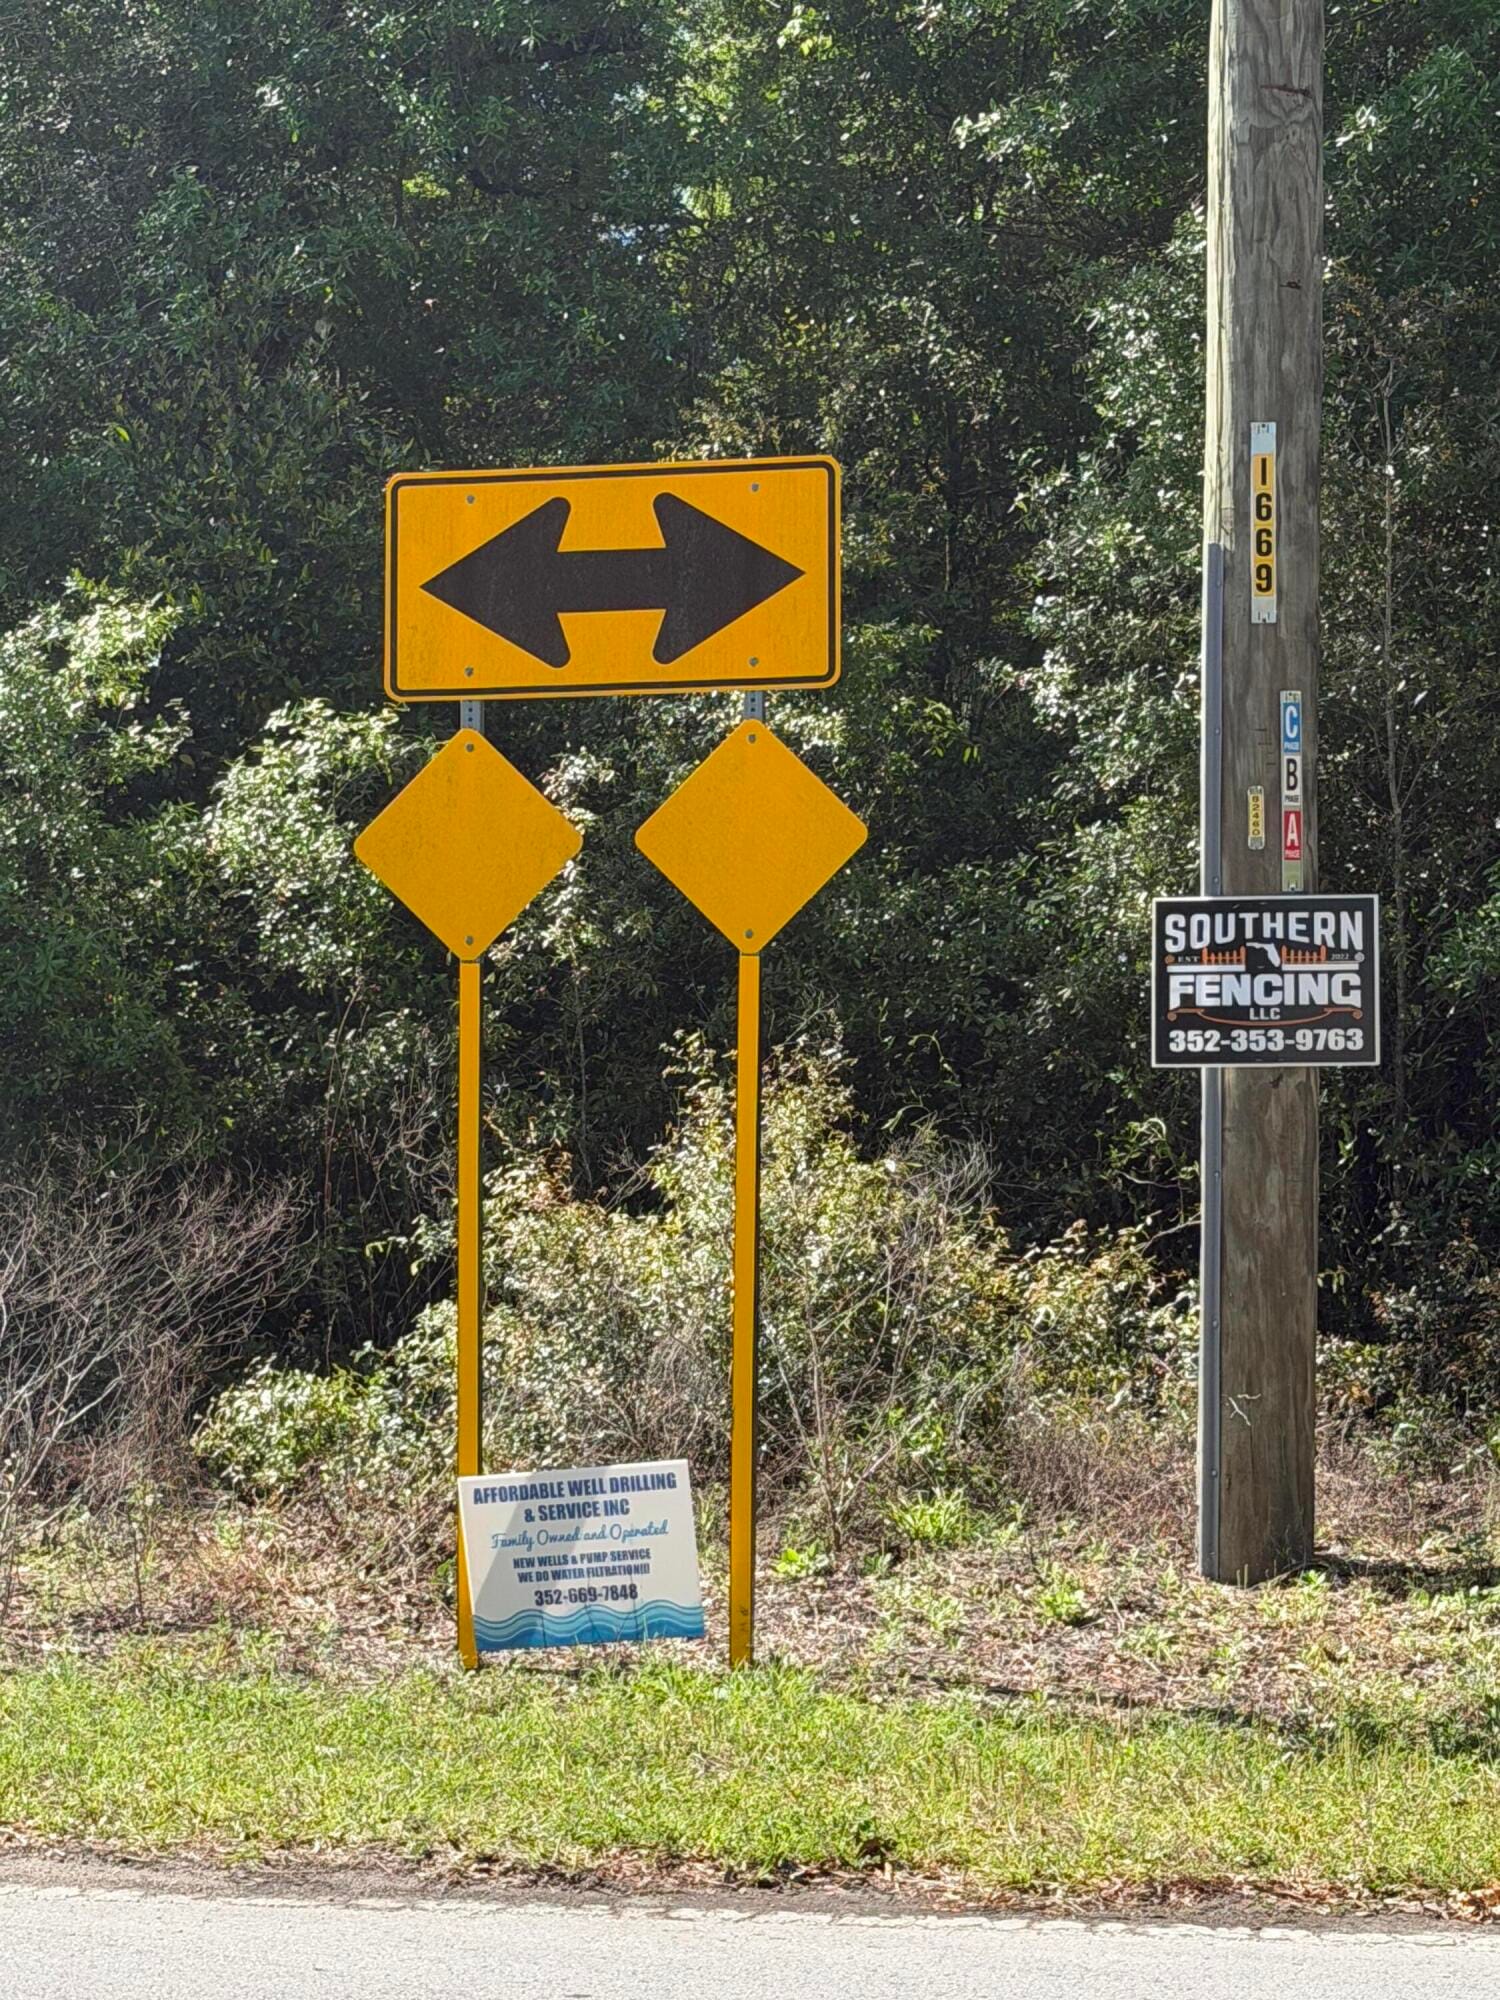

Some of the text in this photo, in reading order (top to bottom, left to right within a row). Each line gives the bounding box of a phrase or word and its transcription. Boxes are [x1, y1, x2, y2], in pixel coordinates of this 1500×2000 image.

[1255, 457, 1273, 593] 1669
[1285, 705, 1299, 739] C
[1286, 758, 1298, 791] B
[1286, 812, 1299, 847] A
[1164, 911, 1363, 953] SOUTHERN
[1168, 973, 1362, 1011] FENCING
[1249, 1007, 1281, 1020] LLC
[1168, 1028, 1364, 1052] 352-353-9763
[473, 1472, 677, 1504] AFFORDABLE WELL DRILLING
[524, 1499, 630, 1523] & SERVICE INC
[491, 1519, 669, 1551] Family Owned and Operated
[513, 1548, 651, 1568] NEW WELLS & PUMP SERVICE
[517, 1571, 534, 1583] WE
[535, 1569, 549, 1581] DO
[550, 1568, 585, 1580] WATER
[534, 1583, 638, 1606] 352-669-7848
